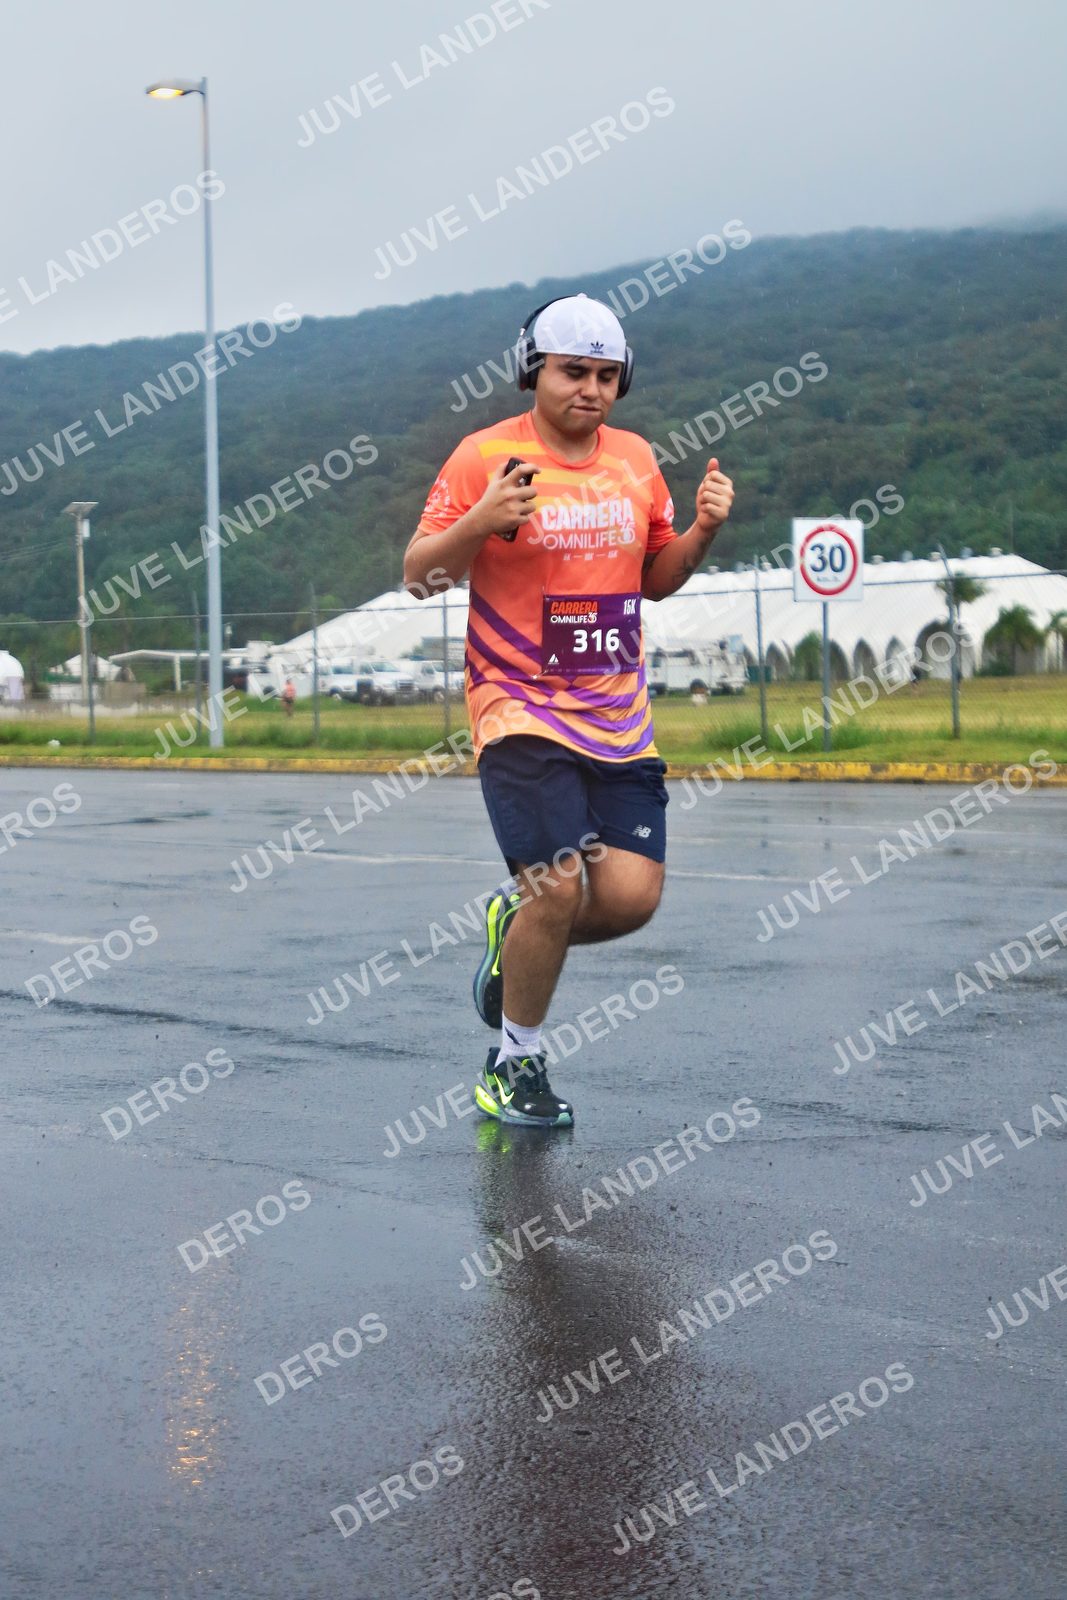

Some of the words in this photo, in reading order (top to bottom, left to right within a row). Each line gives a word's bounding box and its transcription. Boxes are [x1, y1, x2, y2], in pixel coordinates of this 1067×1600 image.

[541, 497, 634, 530] CARRERA
[810, 543, 847, 573] 30
[550, 601, 598, 615] CARRERA
[623, 599, 637, 615] 15K
[572, 628, 620, 653] 316
